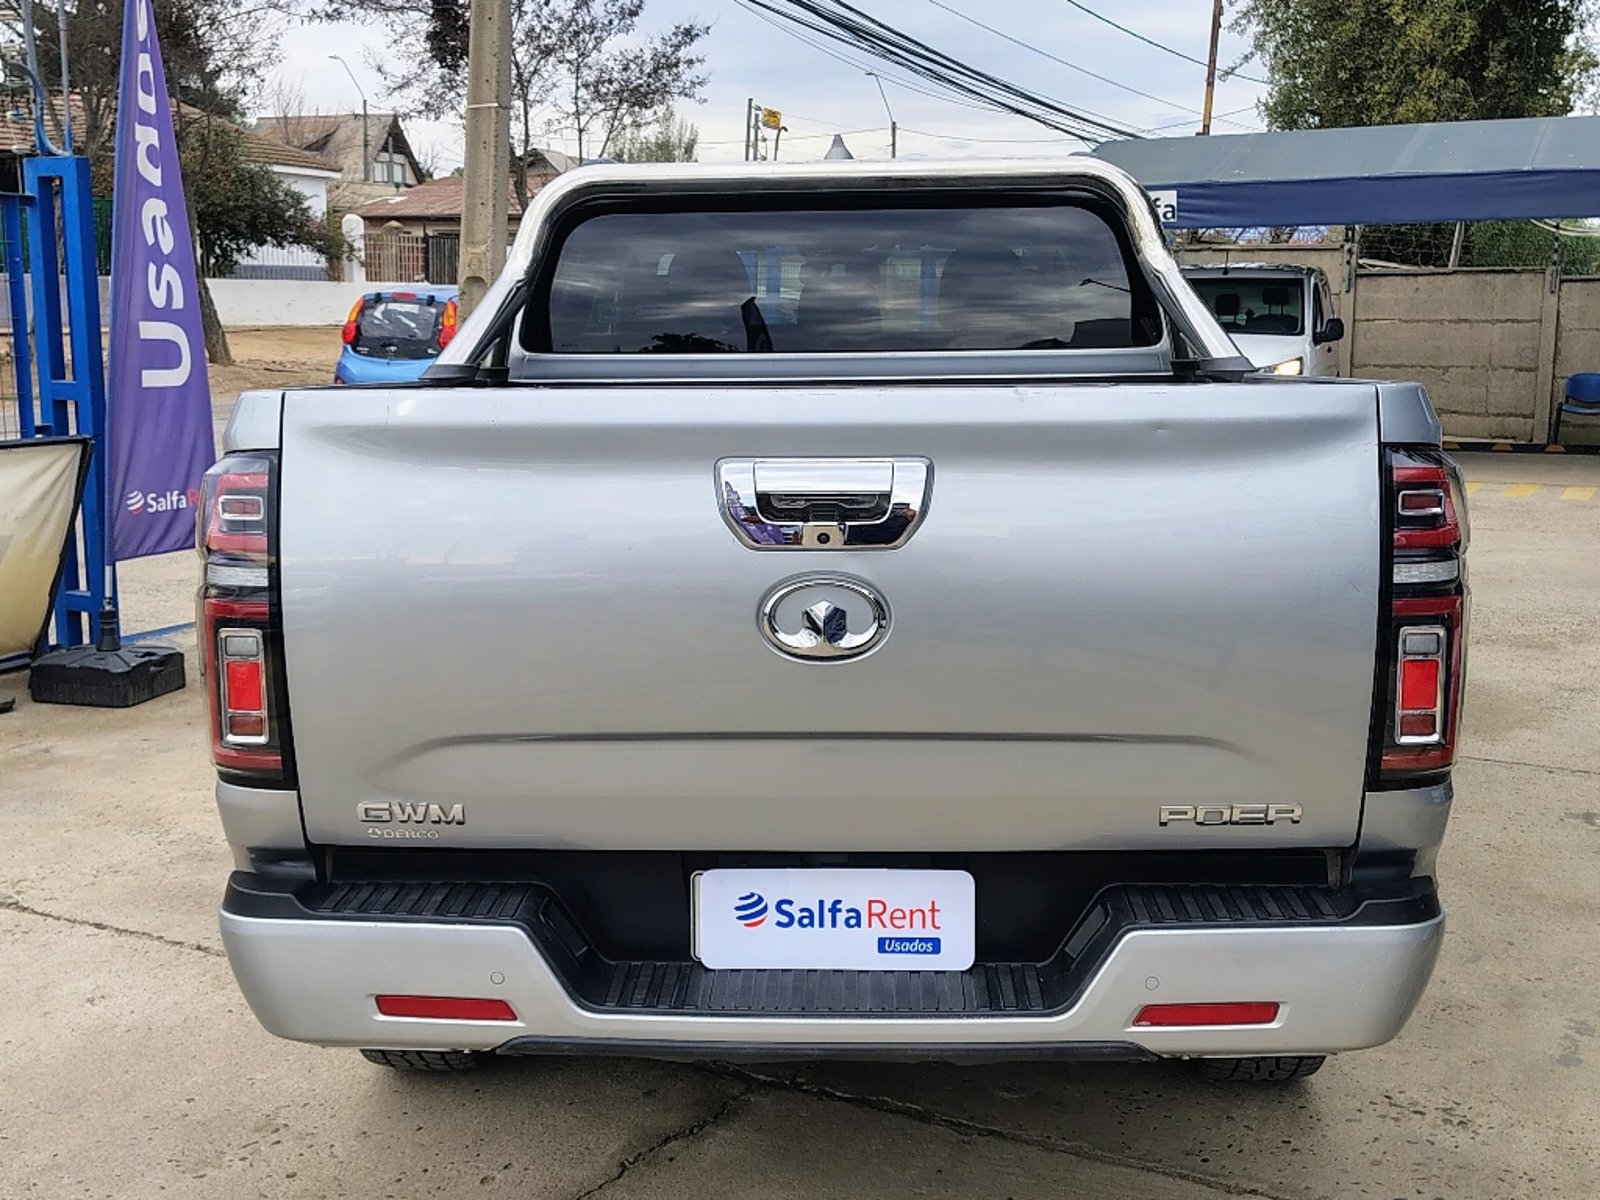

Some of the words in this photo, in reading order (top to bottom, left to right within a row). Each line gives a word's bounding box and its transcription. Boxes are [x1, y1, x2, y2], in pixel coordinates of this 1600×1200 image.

[356, 801, 465, 825] GWM
[1159, 803, 1303, 827] POER
[383, 828, 439, 840] DERCO
[884, 938, 934, 953] Usados
